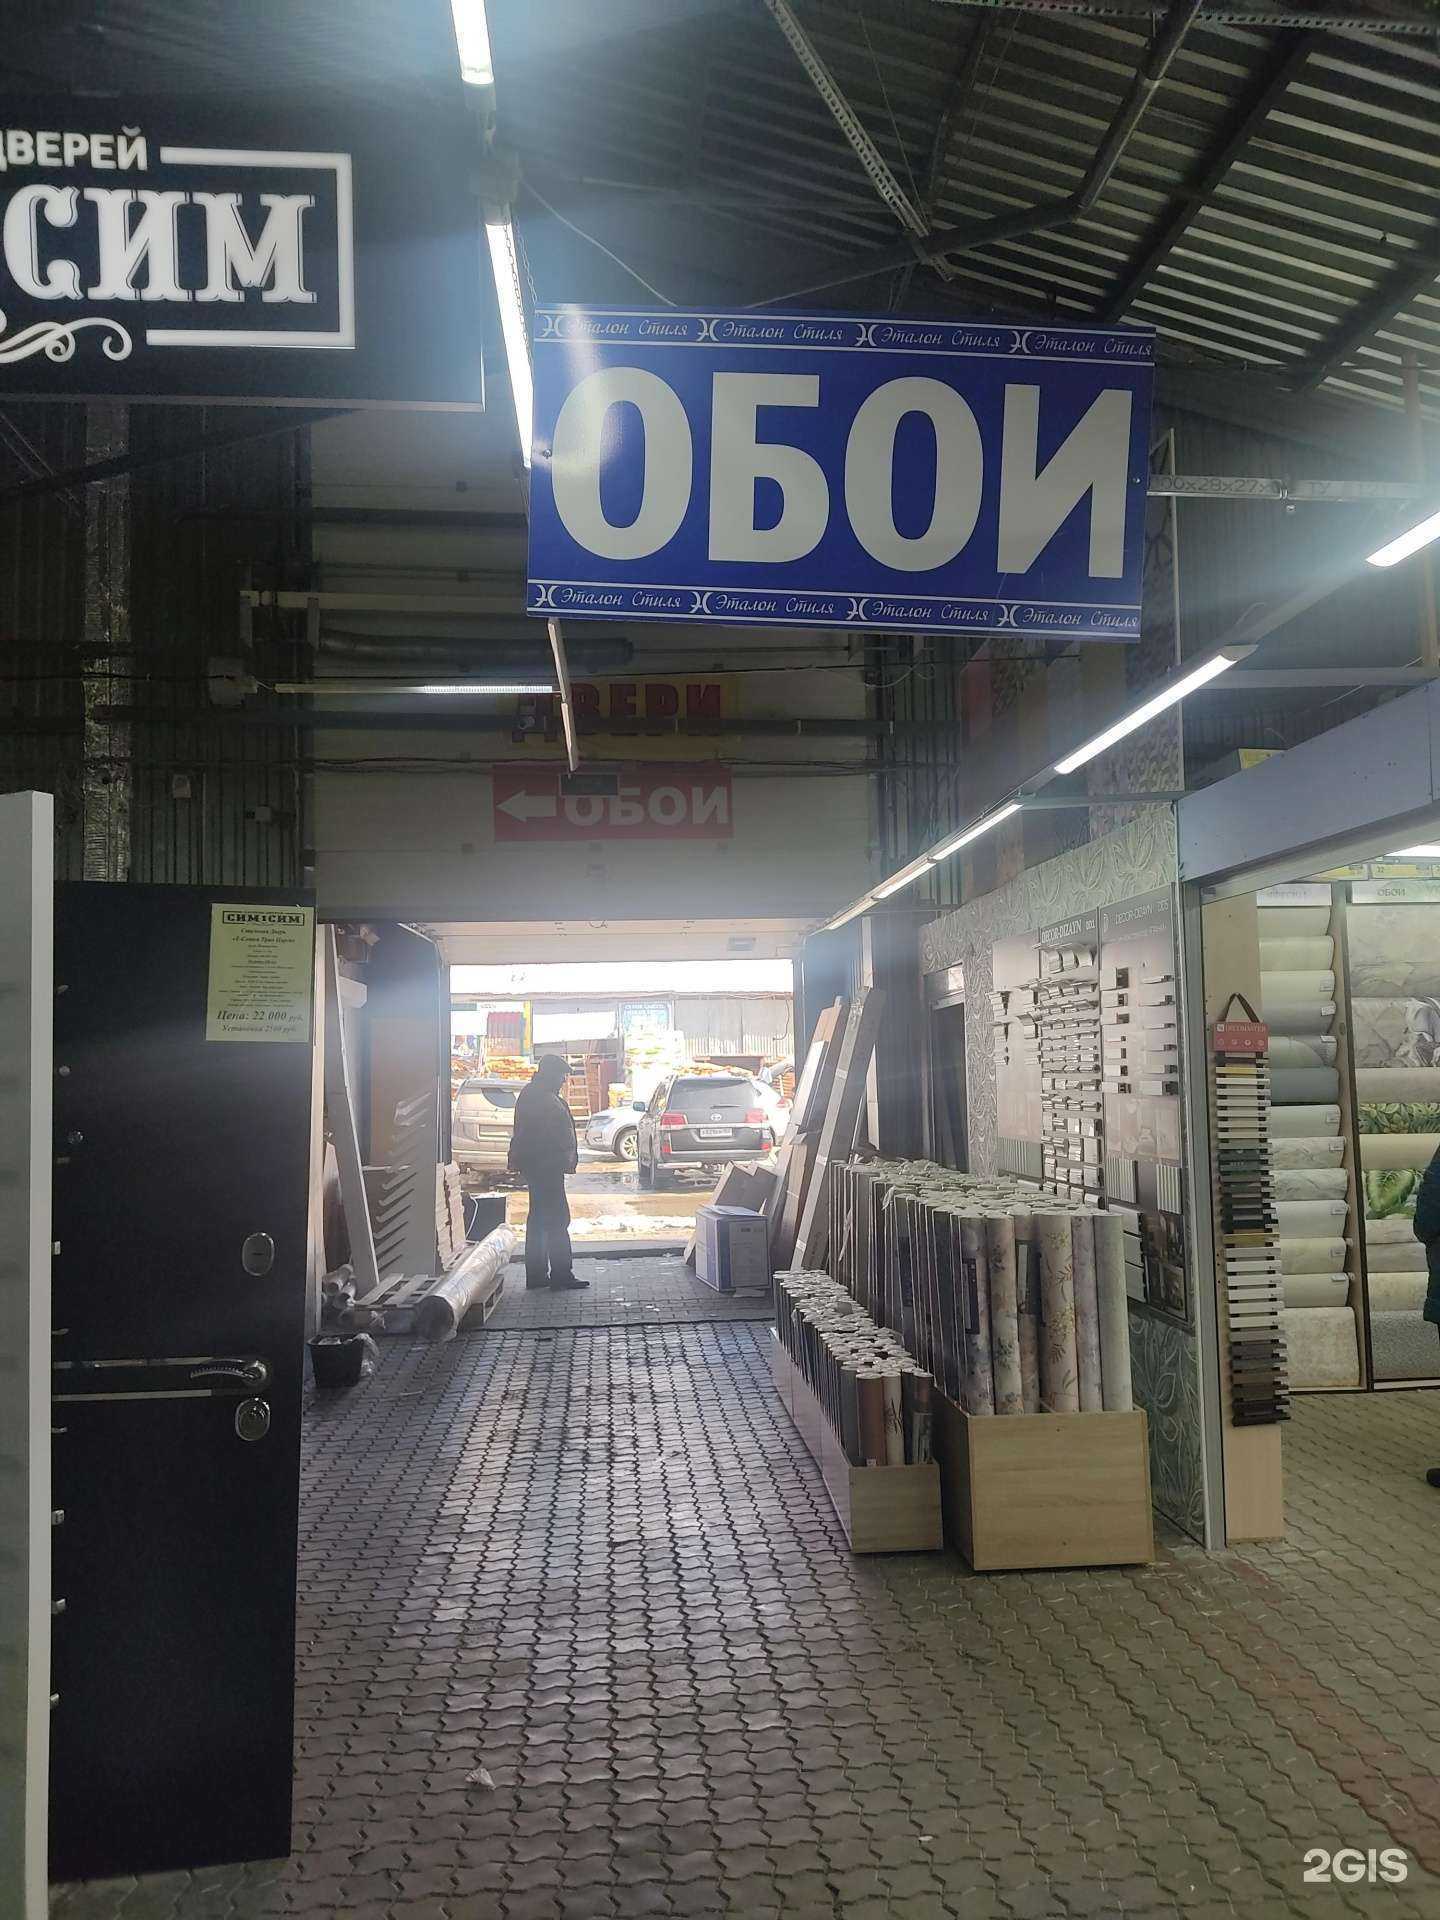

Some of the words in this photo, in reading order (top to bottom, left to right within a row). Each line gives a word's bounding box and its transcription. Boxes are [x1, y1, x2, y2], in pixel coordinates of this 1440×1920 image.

[0, 124, 148, 172] ВЕРЕЙ
[3, 184, 317, 304] СИМ
[568, 319, 629, 335] Эталон
[638, 320, 689, 337] Стиля
[722, 321, 784, 339] Эталон
[793, 322, 843, 340] Стиля
[880, 326, 943, 345] Эталон
[951, 329, 1000, 347] Стиля
[1034, 334, 1096, 353] Эталон
[1104, 337, 1153, 356] Стиля
[551, 366, 1133, 579] ОБОИ
[560, 587, 624, 606] Эталон
[631, 590, 682, 608] Стиля
[715, 594, 777, 613] Эталон
[785, 596, 834, 614] Стиля
[871, 600, 932, 618] Эталон
[940, 602, 989, 621] Стиля
[1022, 607, 1082, 625] Эталон
[1090, 609, 1139, 627] Стиля
[512, 683, 721, 743] ДВЕРИ
[563, 786, 728, 826] ОБОИ
